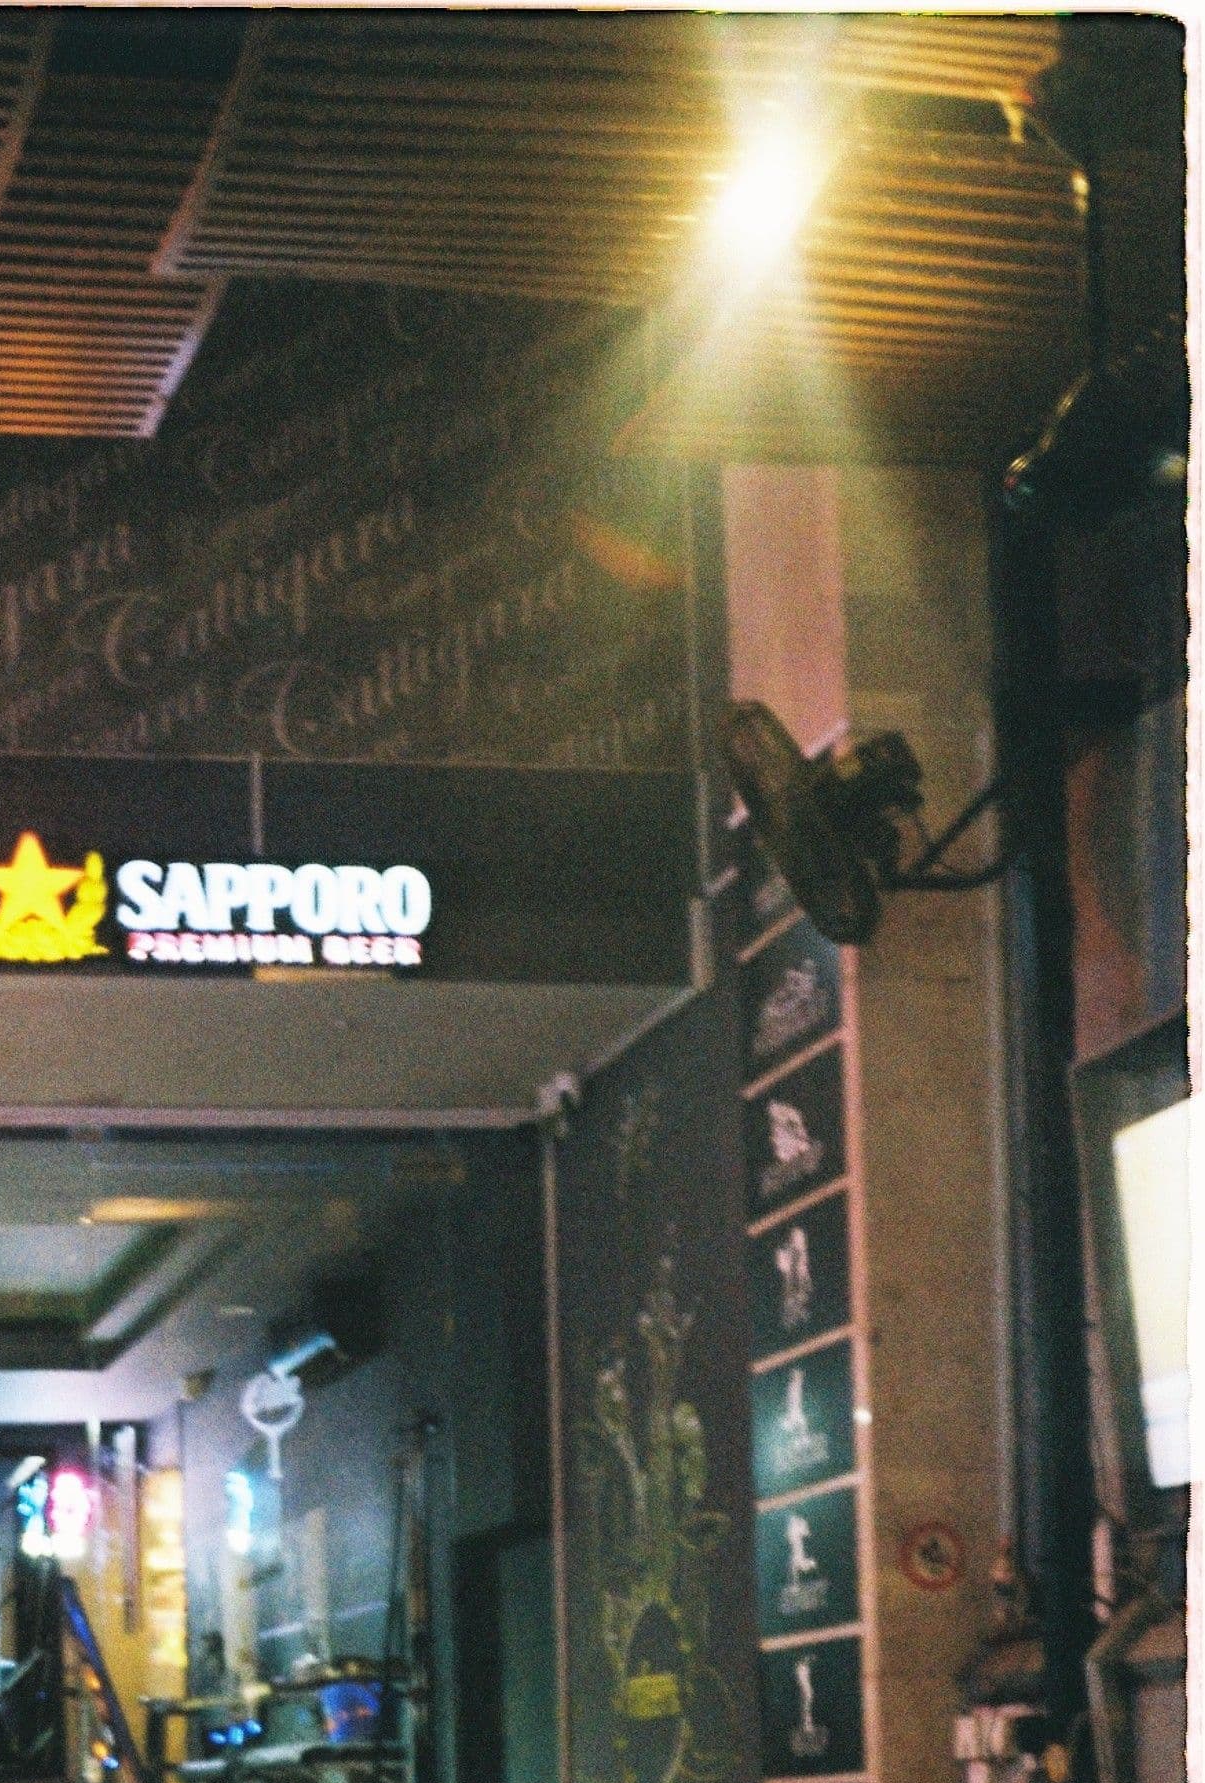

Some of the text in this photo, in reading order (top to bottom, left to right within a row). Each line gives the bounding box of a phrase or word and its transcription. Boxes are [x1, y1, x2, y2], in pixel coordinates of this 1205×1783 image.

[115, 859, 432, 936] SAPPORO
[126, 931, 423, 966] PREMIUM BEER
